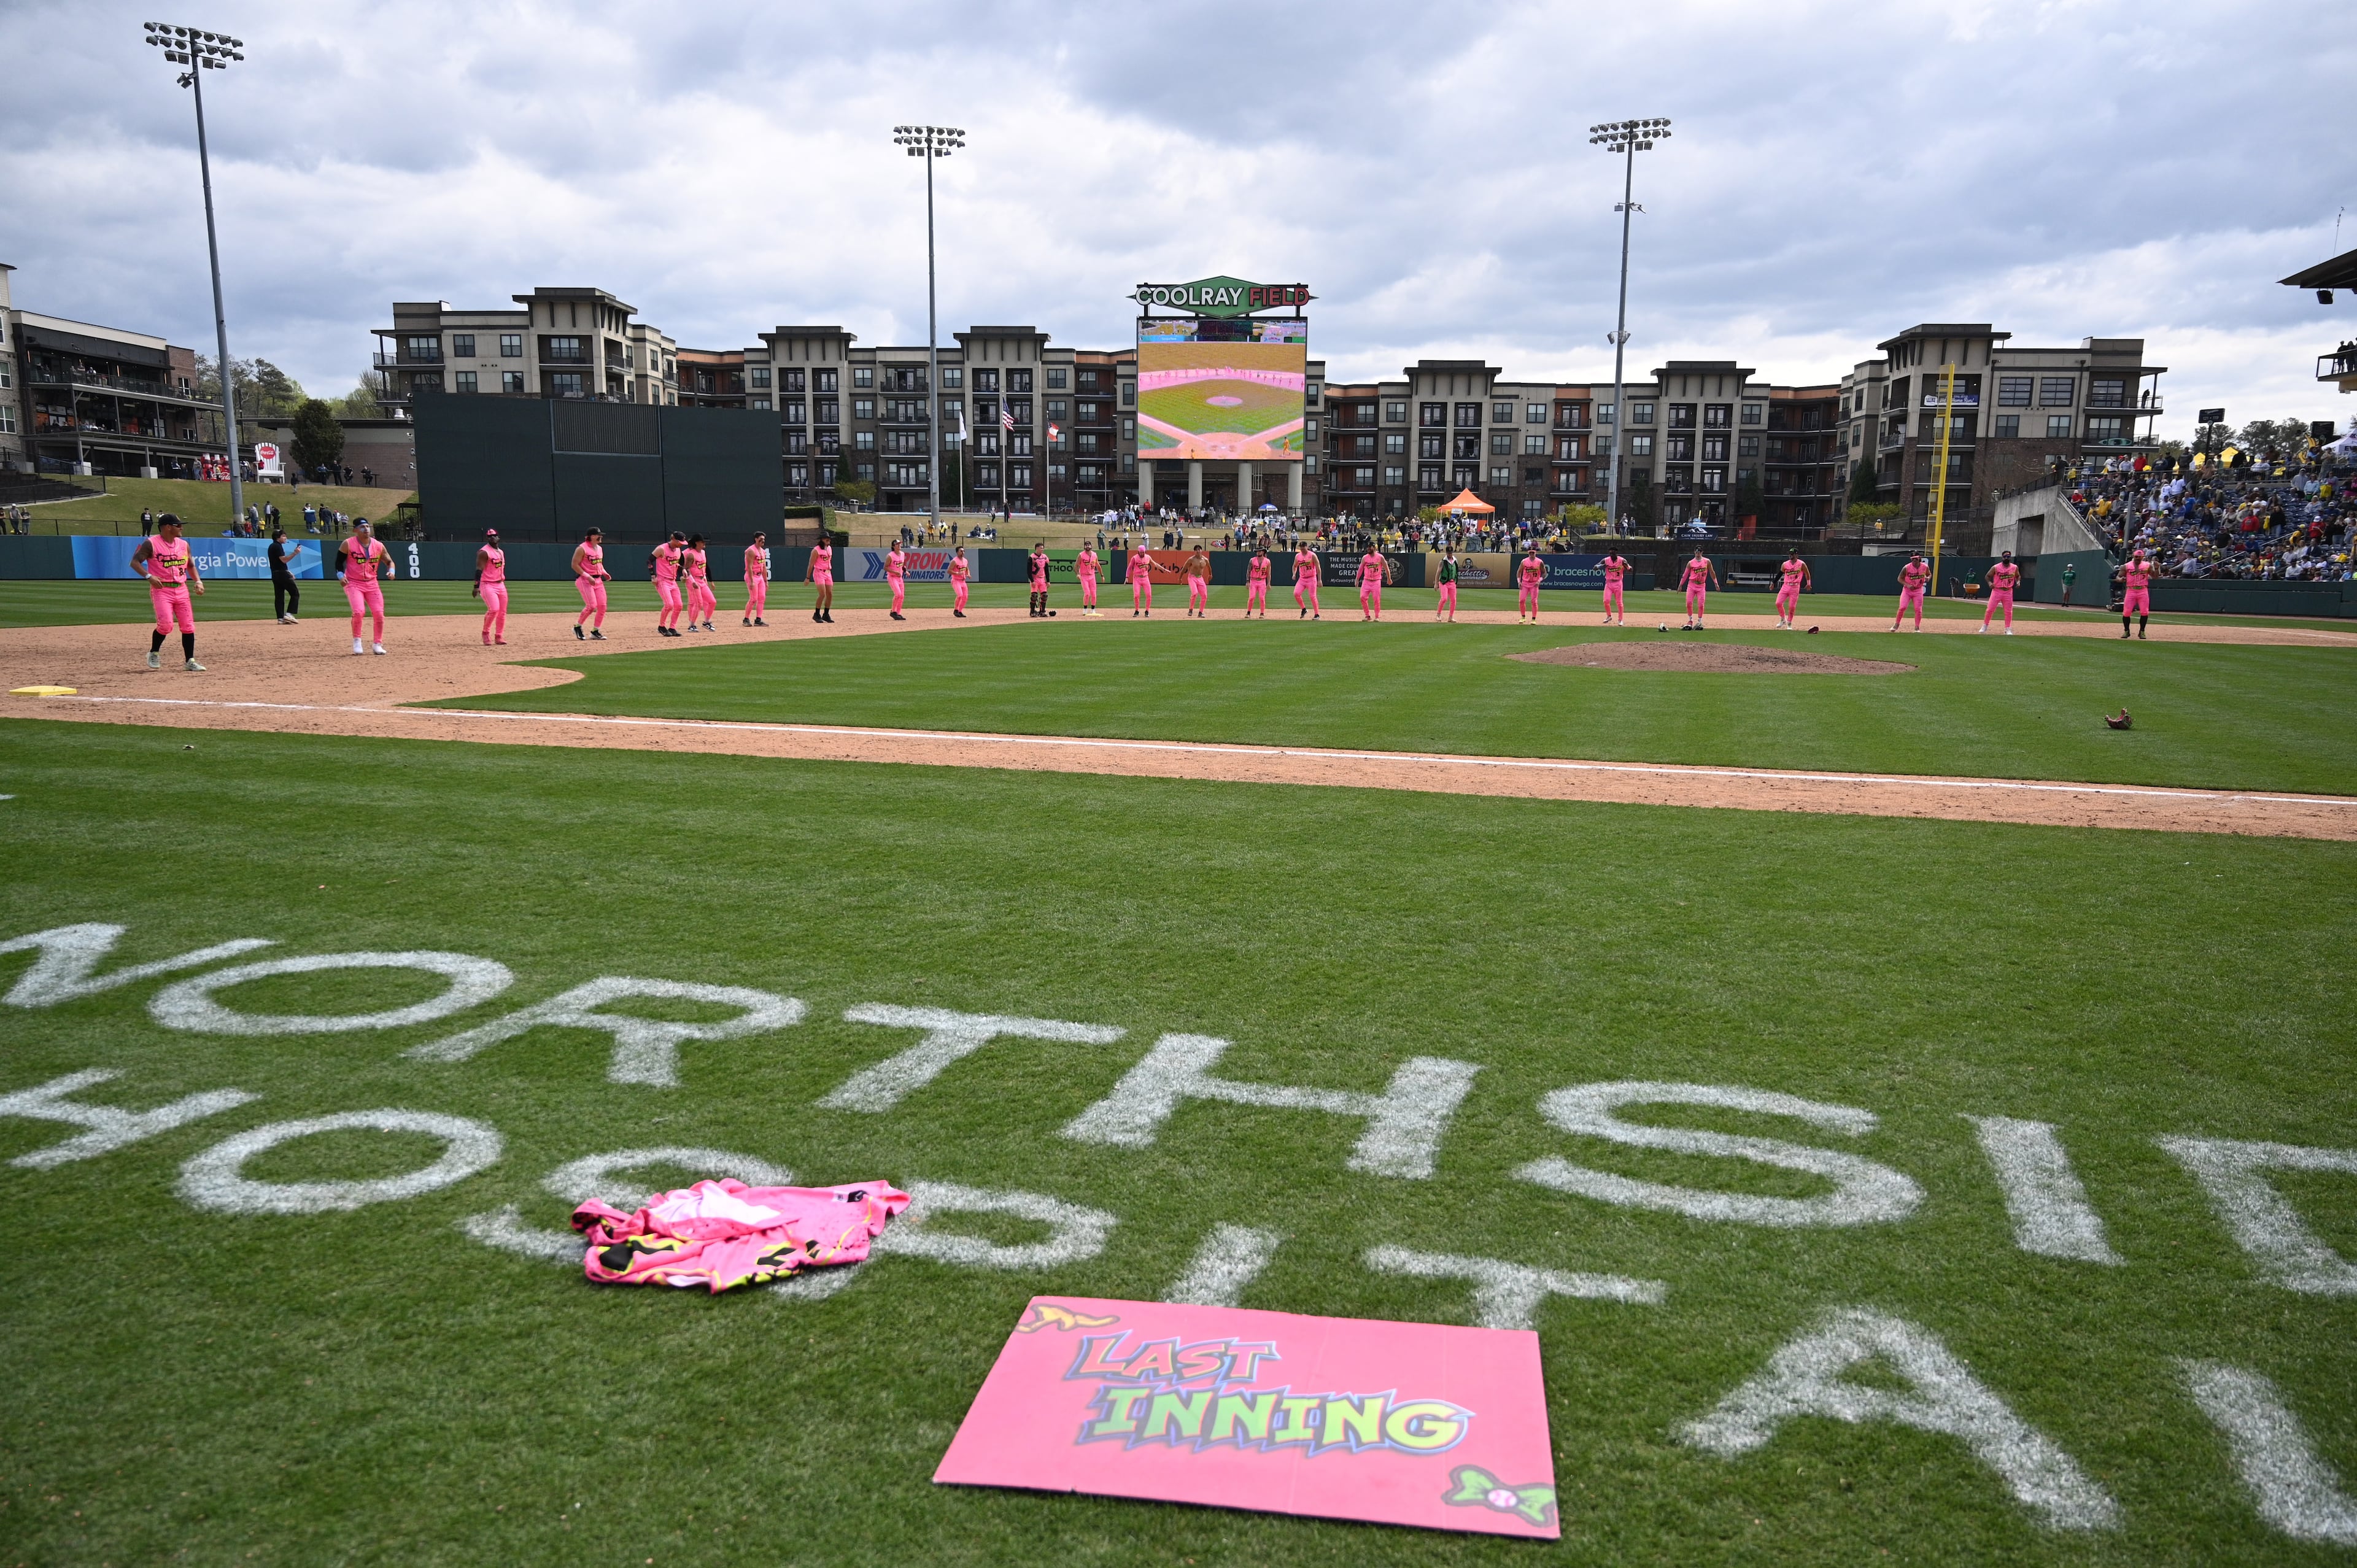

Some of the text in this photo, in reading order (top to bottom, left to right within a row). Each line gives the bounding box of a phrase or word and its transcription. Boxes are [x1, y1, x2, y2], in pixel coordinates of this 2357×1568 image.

[1136, 287, 1310, 306] COOLRAY FIELD
[192, 552, 221, 571] rgia
[904, 552, 947, 570] RROW
[1555, 566, 1588, 576] braces
[1065, 1330, 1282, 1383] LAST
[1075, 1383, 1475, 1458] INNING
